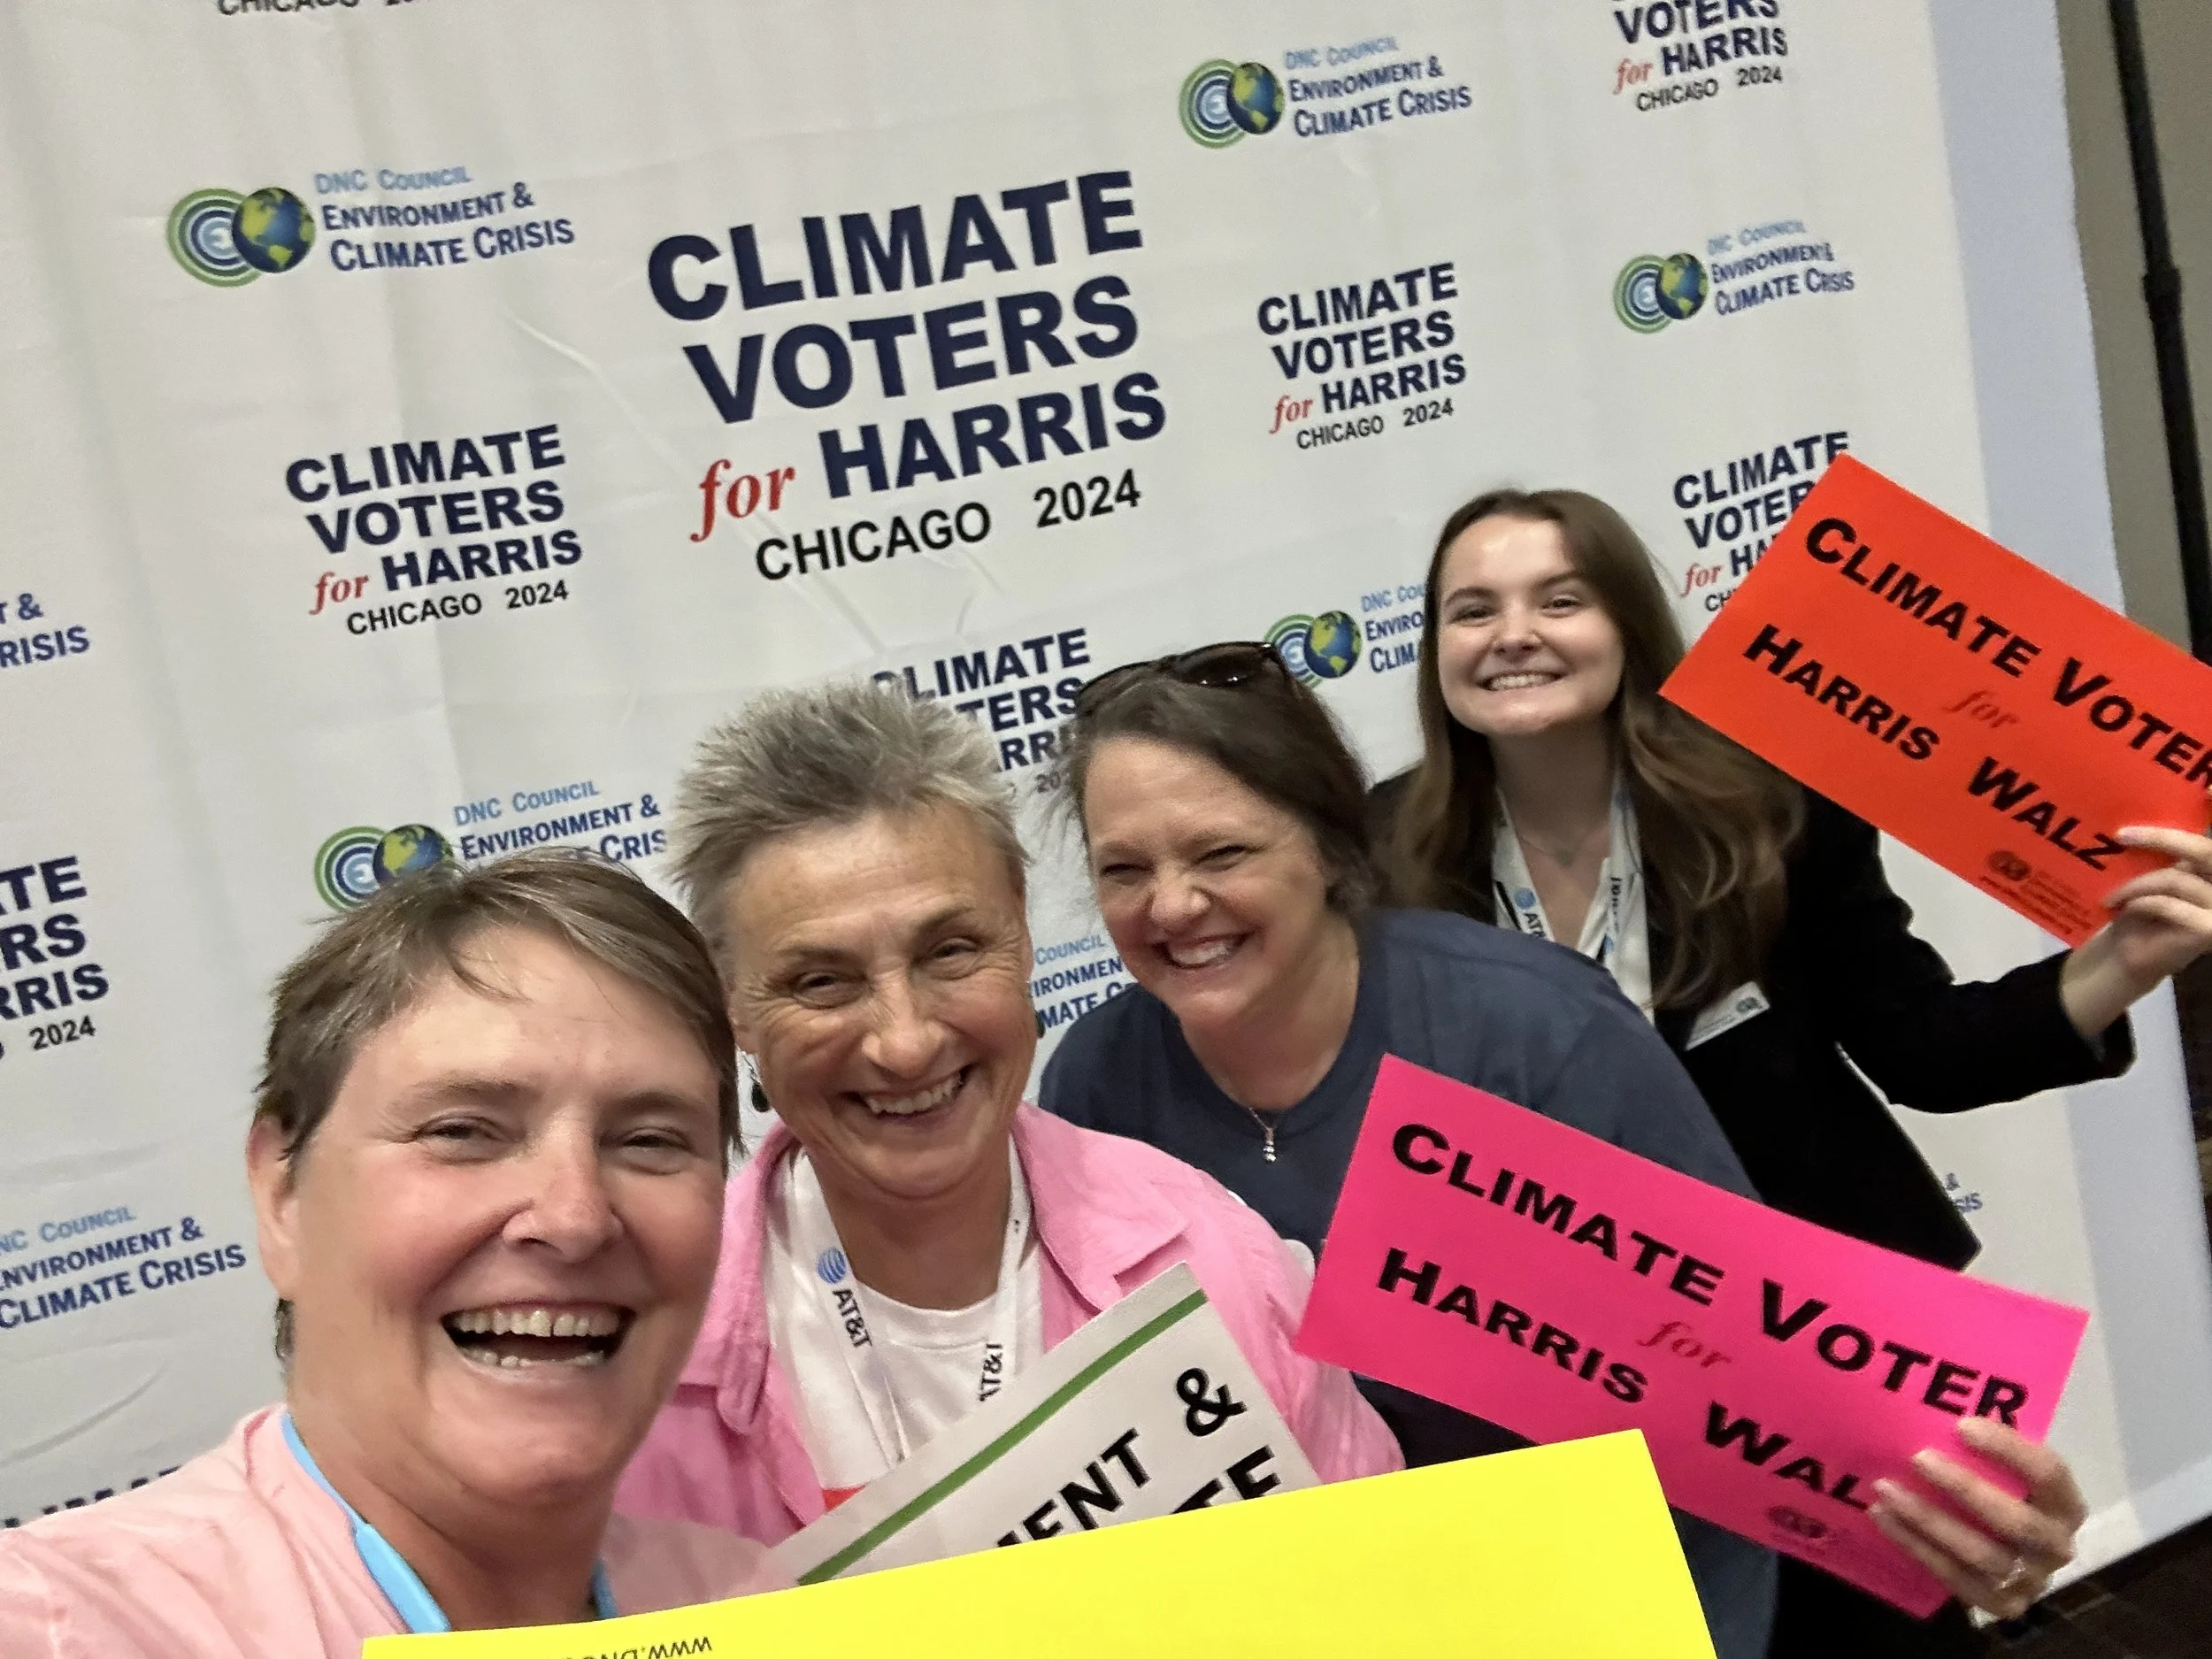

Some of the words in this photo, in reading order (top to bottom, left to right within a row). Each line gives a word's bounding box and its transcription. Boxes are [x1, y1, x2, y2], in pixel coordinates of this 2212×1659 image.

[1614, 0, 1778, 43] VOTERS
[1289, 61, 1422, 102] ENVIRONMENT
[1427, 55, 1444, 77] &
[1612, 58, 1653, 96] for
[1662, 26, 1787, 75] HARRIS
[1294, 98, 1393, 137] CLIMATE
[1398, 86, 1472, 117] CRISIS
[1637, 79, 1719, 111] CHICAGO
[1737, 65, 1783, 87] 2024
[314, 170, 368, 194] DNC
[378, 165, 473, 191] COUNCIL
[321, 191, 505, 230] ENVIRONMENT
[513, 181, 534, 208] &
[331, 238, 468, 271] CLIMATE
[473, 219, 575, 258] CRISIS
[648, 170, 1142, 321] CLIMATE
[1257, 262, 1458, 335] CLIMATE
[1716, 274, 1801, 316] CLIMATE
[682, 275, 1138, 424] VOTERS
[1271, 311, 1455, 380] VOTERS
[1269, 395, 1314, 434] for
[1321, 353, 1466, 413] HARRIS
[1296, 415, 1384, 449] CHICAGO
[1403, 397, 1455, 426] 2024
[286, 424, 565, 503] CLIMATE
[690, 458, 795, 542] for
[818, 372, 1166, 498] HARRIS
[306, 480, 565, 554] VOTERS
[756, 502, 992, 580] CHICAGO
[1033, 468, 1141, 528] 2024
[1684, 480, 1816, 549] VOTER
[310, 571, 370, 615] for
[381, 529, 582, 591] HARRIS
[1679, 563, 1722, 598] for
[1805, 517, 2042, 678] CLIMATE
[19, 593, 43, 620] &
[348, 593, 482, 634] CHICAGO
[506, 579, 570, 610] 2024
[1361, 589, 1393, 613] DNC
[1365, 611, 1425, 641] ENVIRO
[0, 626, 90, 668] RISIS
[1371, 642, 1416, 673] CLIM
[956, 677, 1084, 733] TERS
[1947, 688, 2020, 731] for
[1743, 623, 1941, 761] HARRIS
[1967, 757, 2128, 872] WALZ
[454, 797, 503, 826] DNC
[512, 780, 600, 812] COUNCIL
[460, 802, 634, 861] ENVIRONMENT
[640, 794, 662, 818] &
[600, 829, 668, 864] CRIS
[1035, 933, 1105, 965] COUNCIL
[1032, 956, 1123, 997] IRONMEN
[29, 1014, 96, 1050] 2024
[1037, 992, 1098, 1028] MATE
[0, 1229, 28, 1255] NC
[40, 1205, 136, 1243] COUNCIL
[0, 1226, 173, 1291] NVIRONMENT
[180, 1216, 204, 1241] &
[0, 1271, 136, 1329] CLIMATE
[140, 1243, 247, 1290] CRISIS
[1392, 1124, 1725, 1308] CLIMATE
[1760, 1278, 2029, 1431] VOTER
[833, 1288, 873, 1348] AT&T
[1635, 1320, 1735, 1373] for
[1176, 1367, 1248, 1438] &
[1376, 1247, 1649, 1405] HARRIS
[1704, 1403, 1870, 1513] WAL
